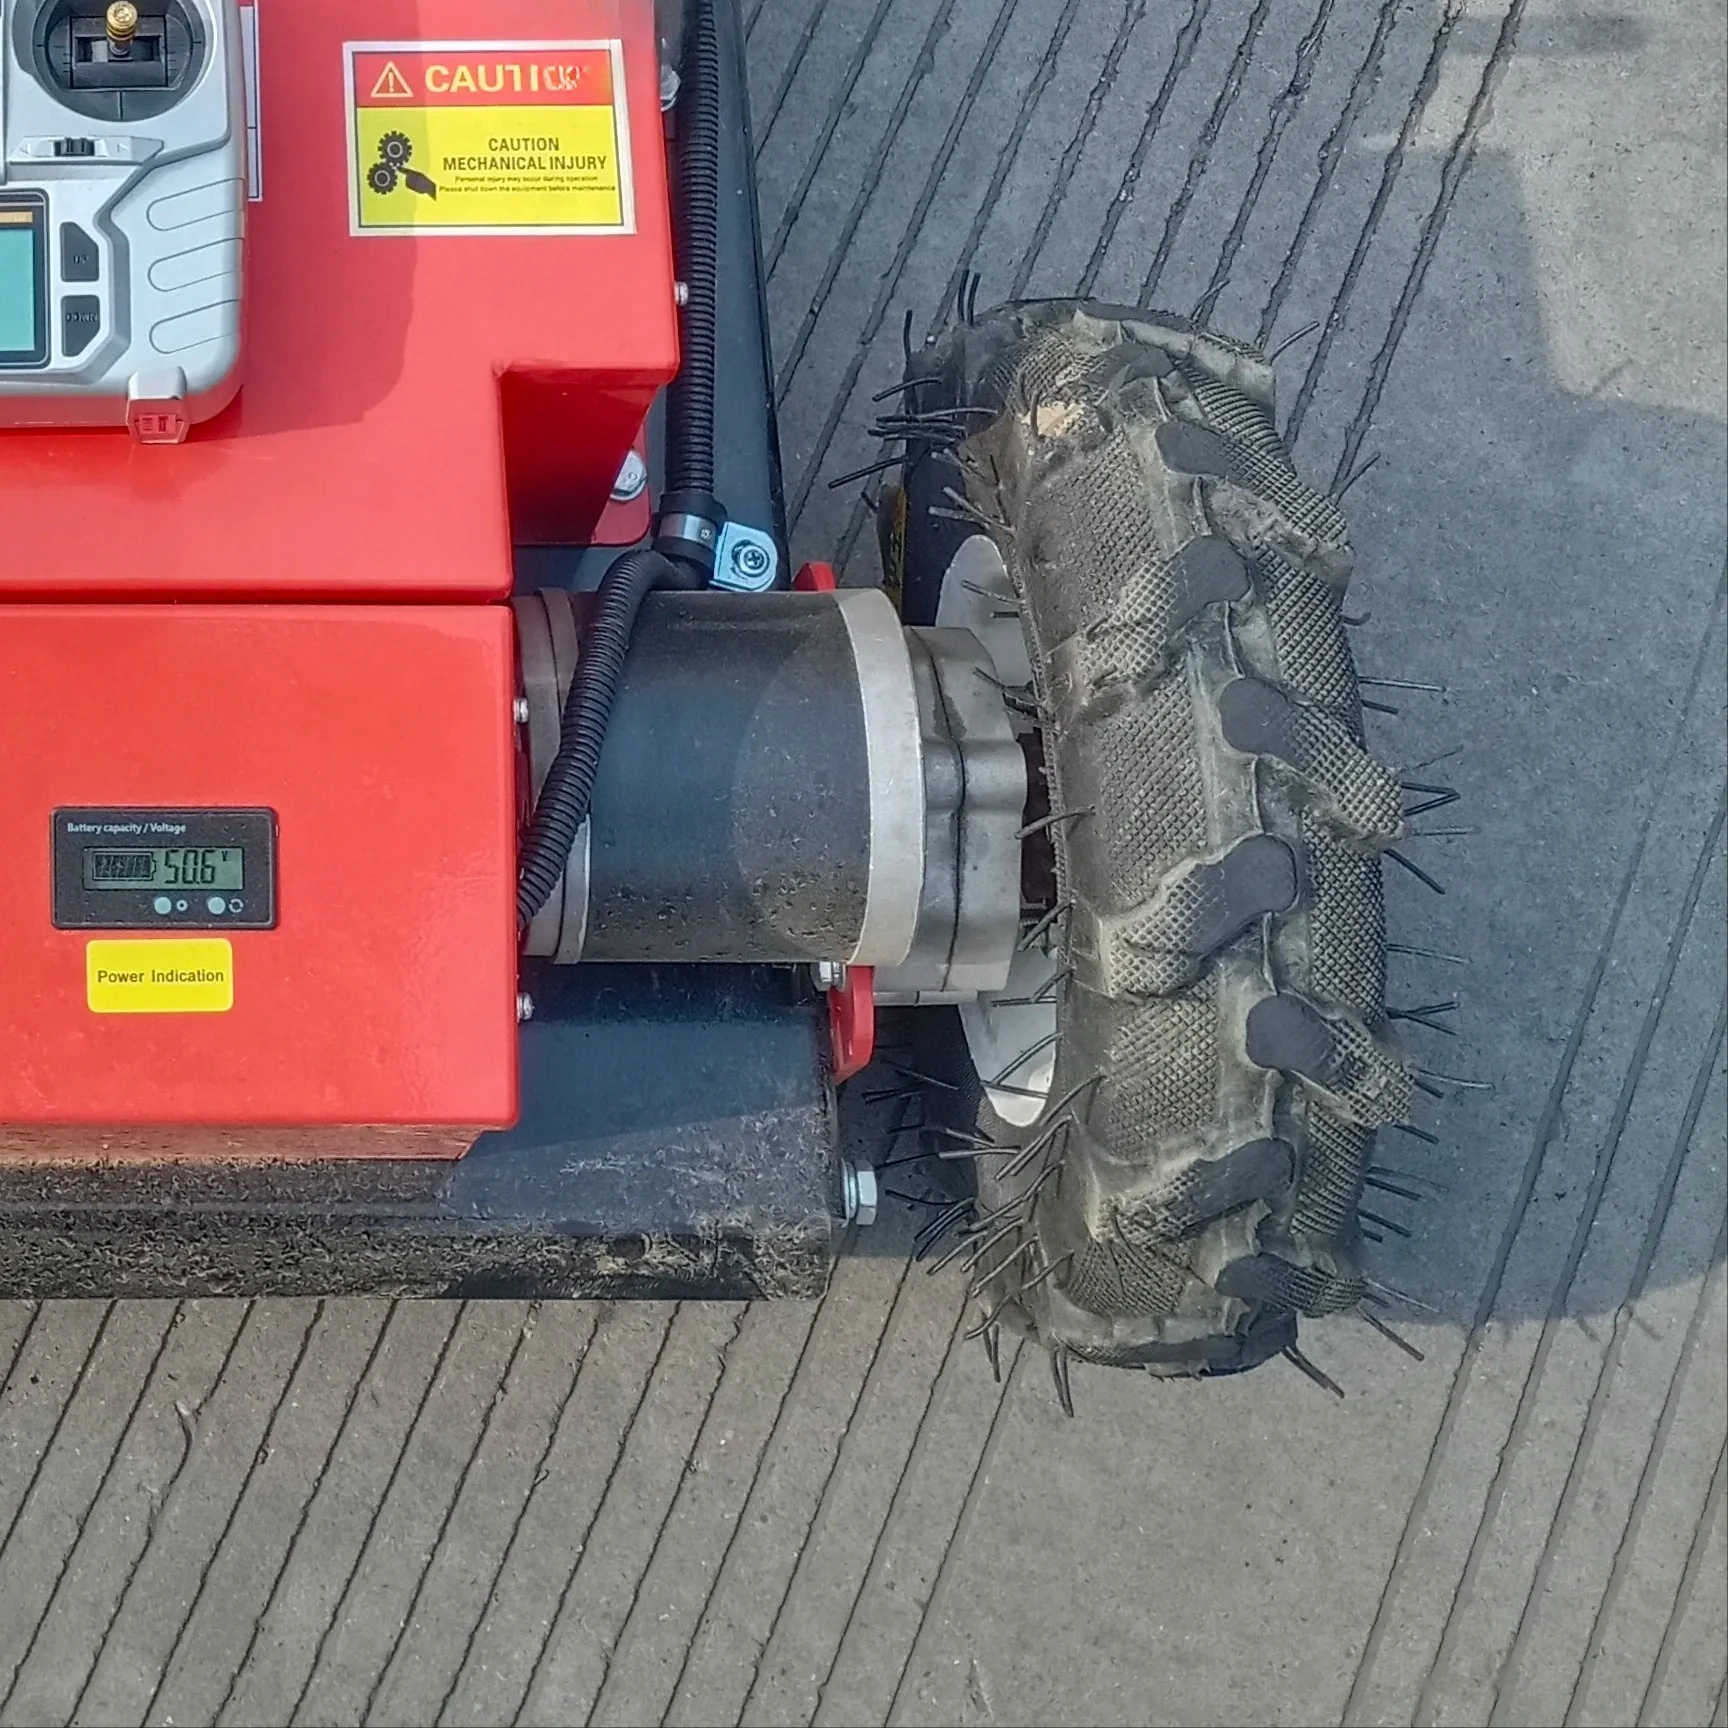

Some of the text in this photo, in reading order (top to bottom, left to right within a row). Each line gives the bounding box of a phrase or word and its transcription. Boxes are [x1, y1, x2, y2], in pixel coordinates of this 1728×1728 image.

[488, 137, 560, 152] CAUTION
[443, 155, 607, 171] MECHANICAL INJURY
[67, 822, 101, 834] Battery
[103, 823, 142, 835] capacity
[150, 822, 187, 834] Voltage
[164, 849, 216, 885] 50.6
[97, 968, 224, 983] Power Indication
